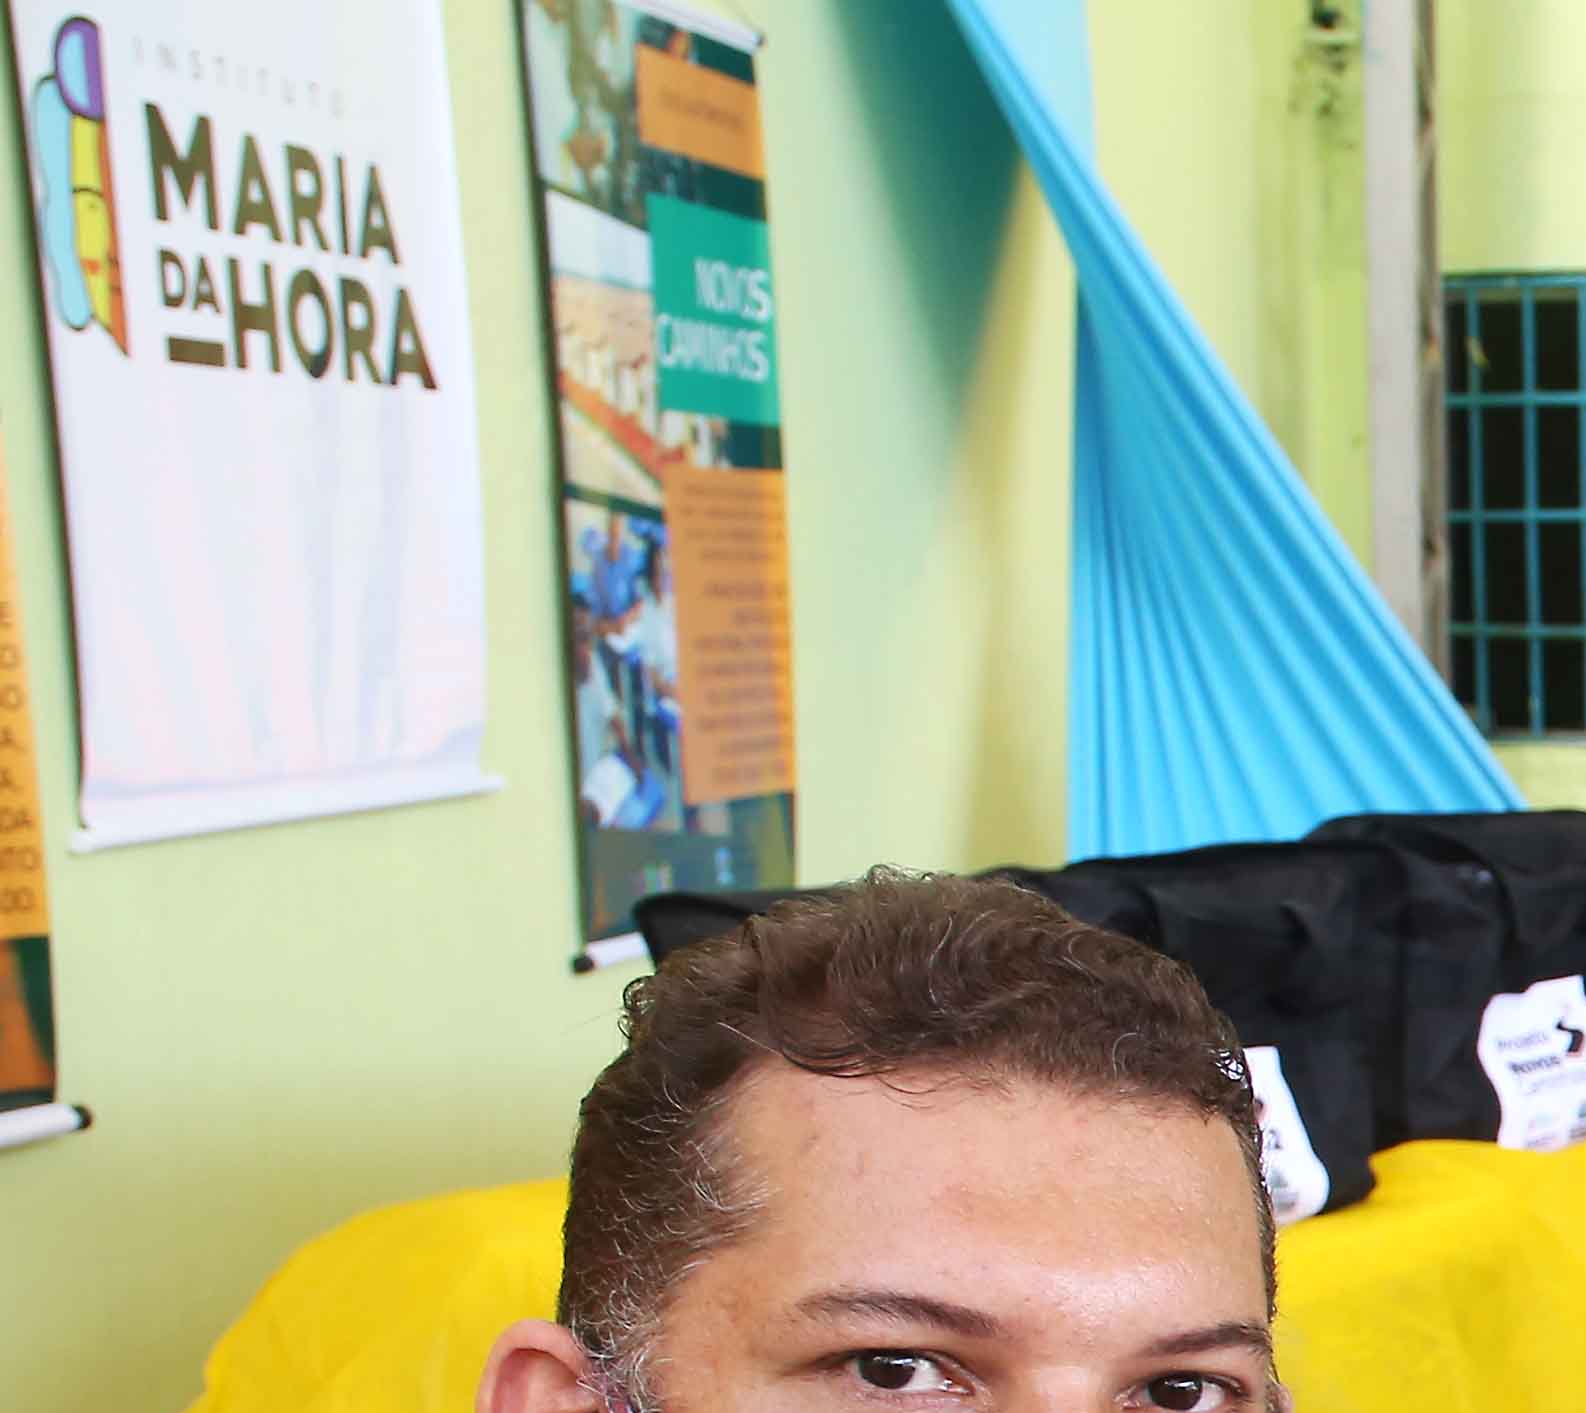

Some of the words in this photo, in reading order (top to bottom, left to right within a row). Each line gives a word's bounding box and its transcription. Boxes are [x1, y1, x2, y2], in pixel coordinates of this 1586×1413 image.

[143, 100, 401, 266] MARIA
[158, 247, 221, 315] DA
[228, 256, 438, 391] HORA
